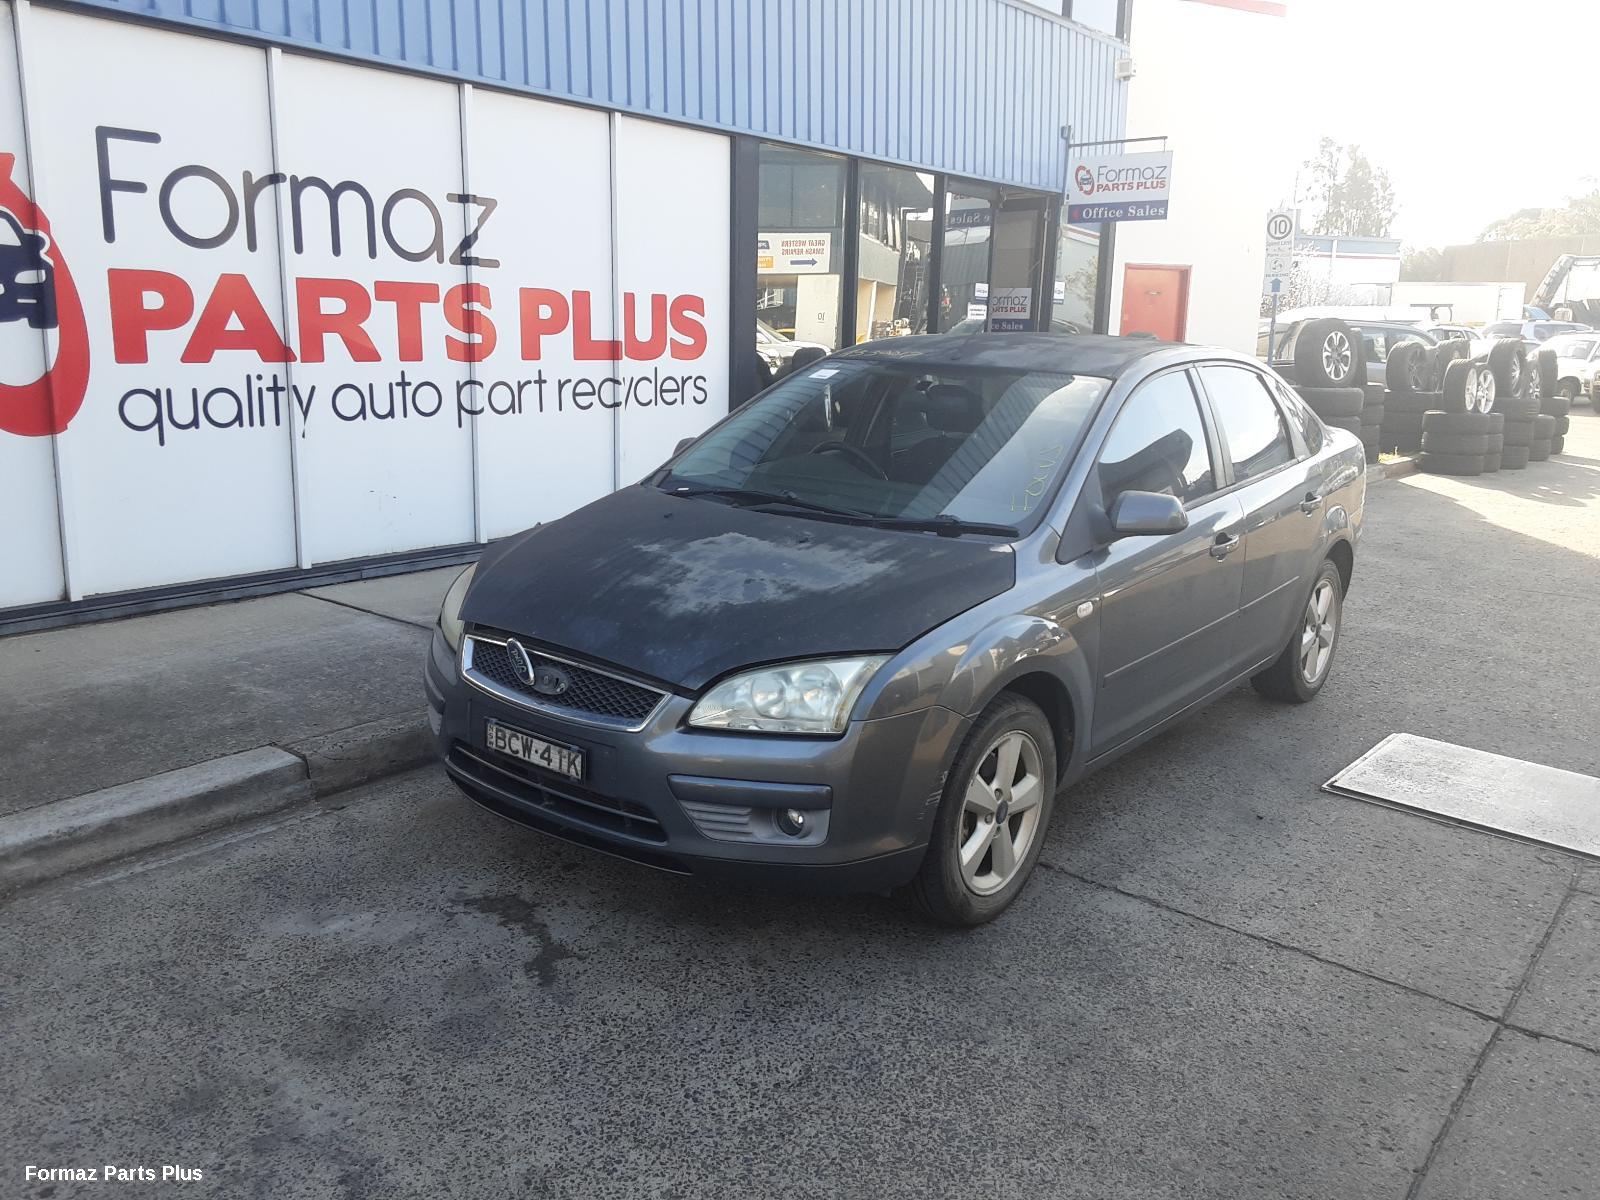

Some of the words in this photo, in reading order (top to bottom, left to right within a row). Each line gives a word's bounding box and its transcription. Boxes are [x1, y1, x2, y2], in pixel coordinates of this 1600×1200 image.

[1097, 165, 1168, 182] Formaz
[1096, 182, 1134, 192] PARTS
[1136, 180, 1166, 190] PLUS
[95, 125, 501, 269] Formaz
[1082, 207, 1124, 219] Office
[1127, 205, 1165, 217] Sales
[1274, 219, 1287, 235] 10
[106, 268, 498, 365] PARTS
[518, 286, 708, 362] PLUS
[118, 373, 317, 447] quality
[331, 370, 443, 422] auto
[456, 368, 545, 429] part
[557, 366, 709, 415] recyclers
